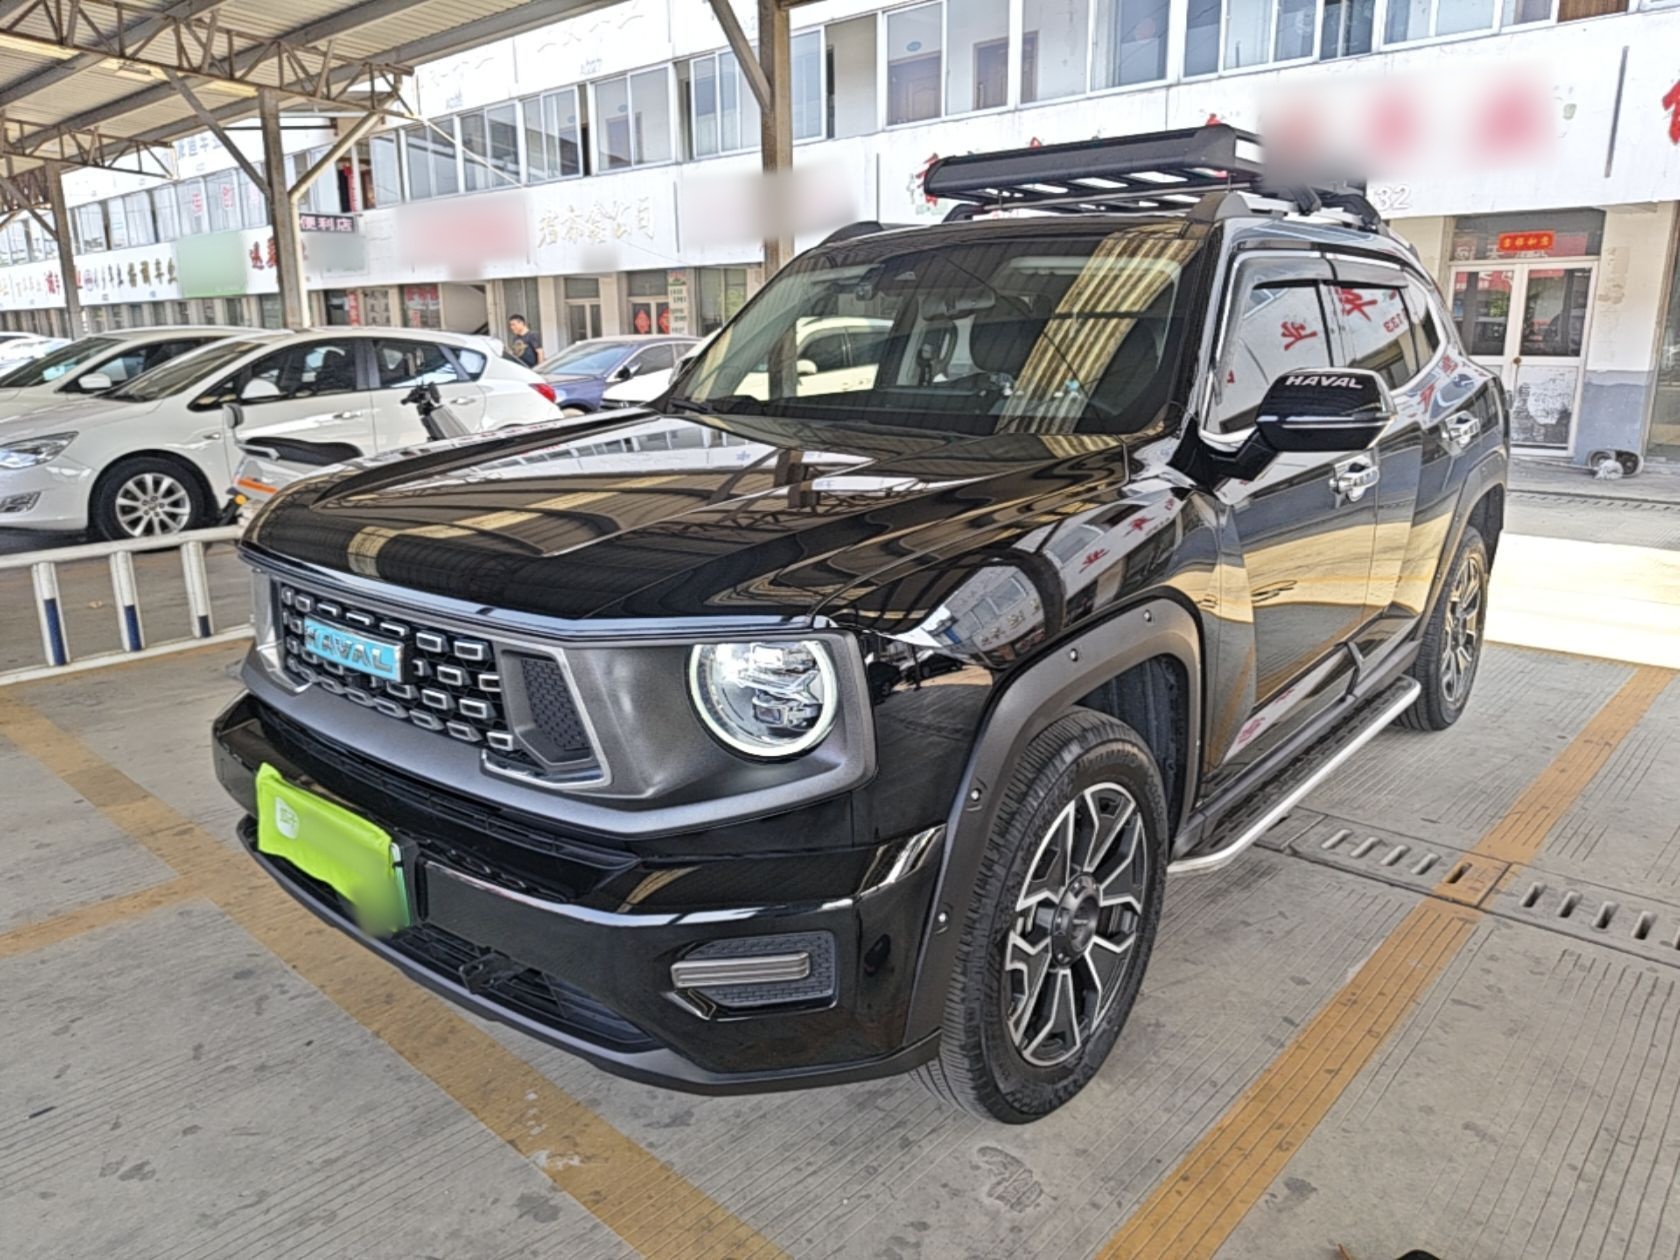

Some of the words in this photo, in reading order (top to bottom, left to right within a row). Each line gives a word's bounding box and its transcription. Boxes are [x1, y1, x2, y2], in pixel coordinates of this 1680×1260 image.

[300, 215, 353, 231] 便利店
[1283, 375, 1363, 389] HAVAL
